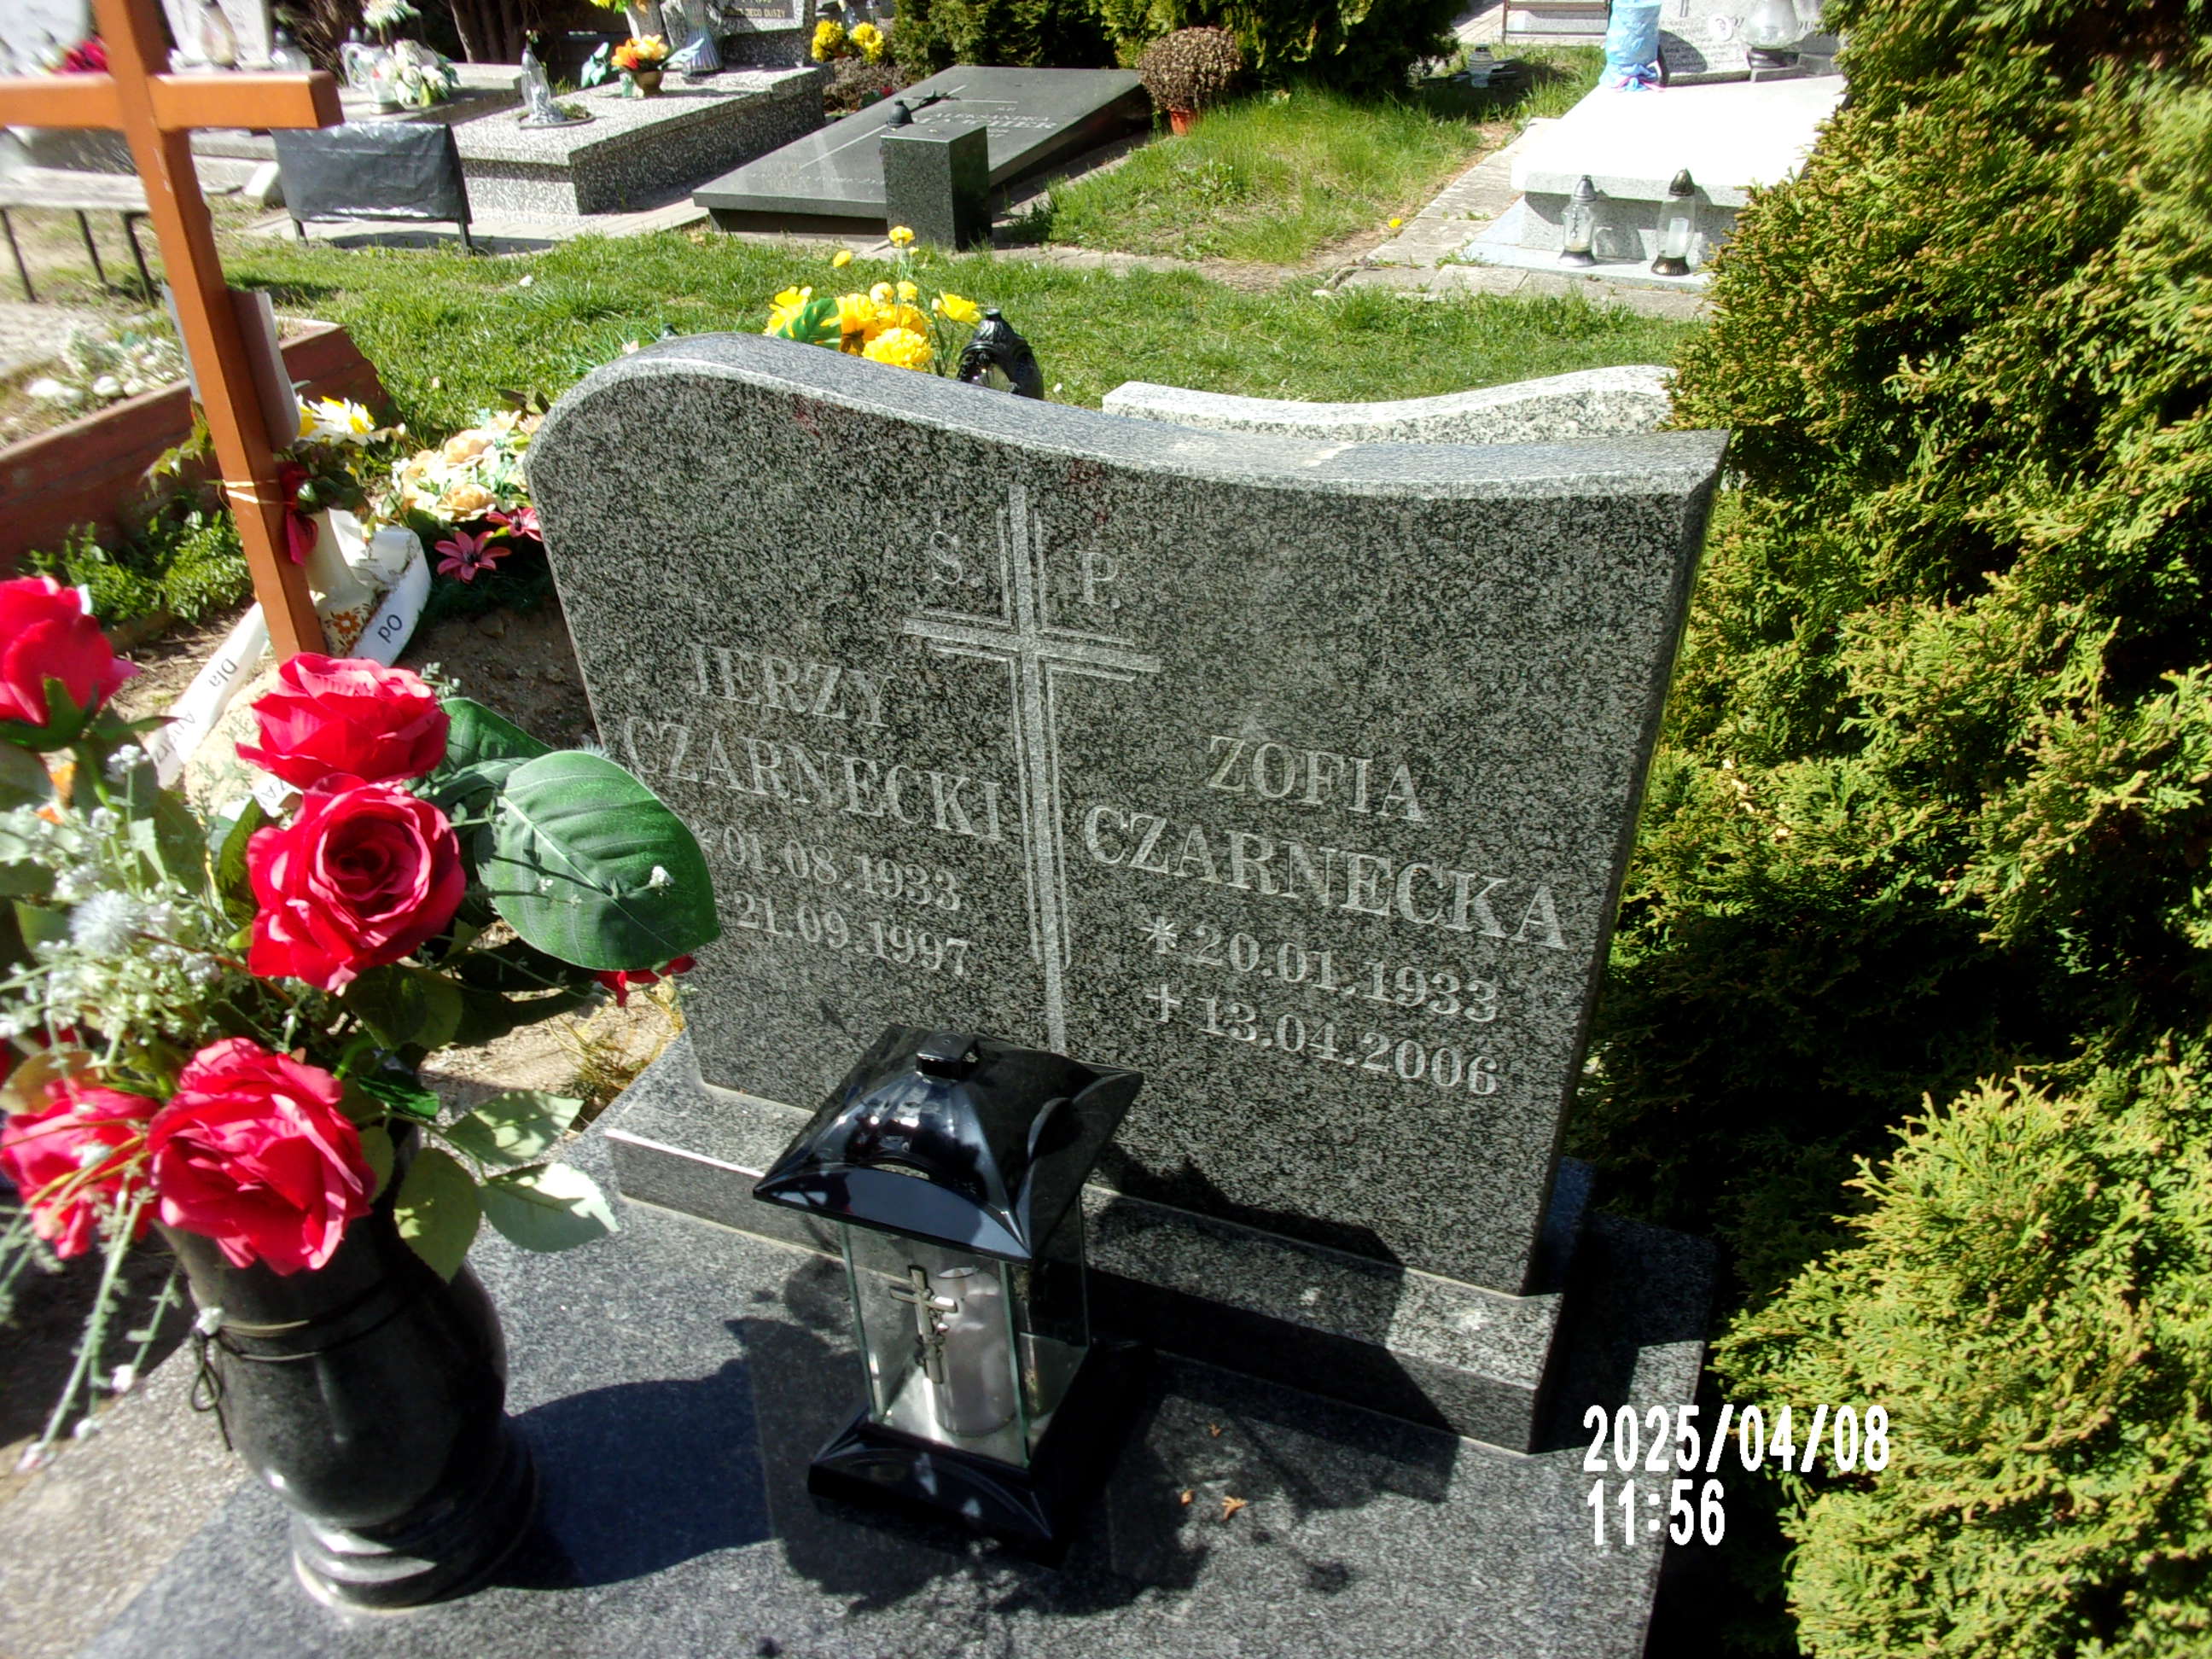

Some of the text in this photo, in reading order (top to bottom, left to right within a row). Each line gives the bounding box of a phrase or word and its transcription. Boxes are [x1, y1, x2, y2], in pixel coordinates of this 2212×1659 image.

[378, 614, 403, 643] Od
[208, 658, 238, 687] Dla
[689, 644, 895, 727] JERZY
[623, 716, 1003, 841] CZARNECKI
[1208, 734, 1423, 822] ZOFIA
[724, 825, 961, 911] 01.08.1933
[1084, 805, 1569, 952] CZARNECKA
[734, 890, 969, 975] 21.09.1997
[1196, 925, 1499, 1023] 20.01.1933
[1197, 997, 1499, 1096] 13.04.2006
